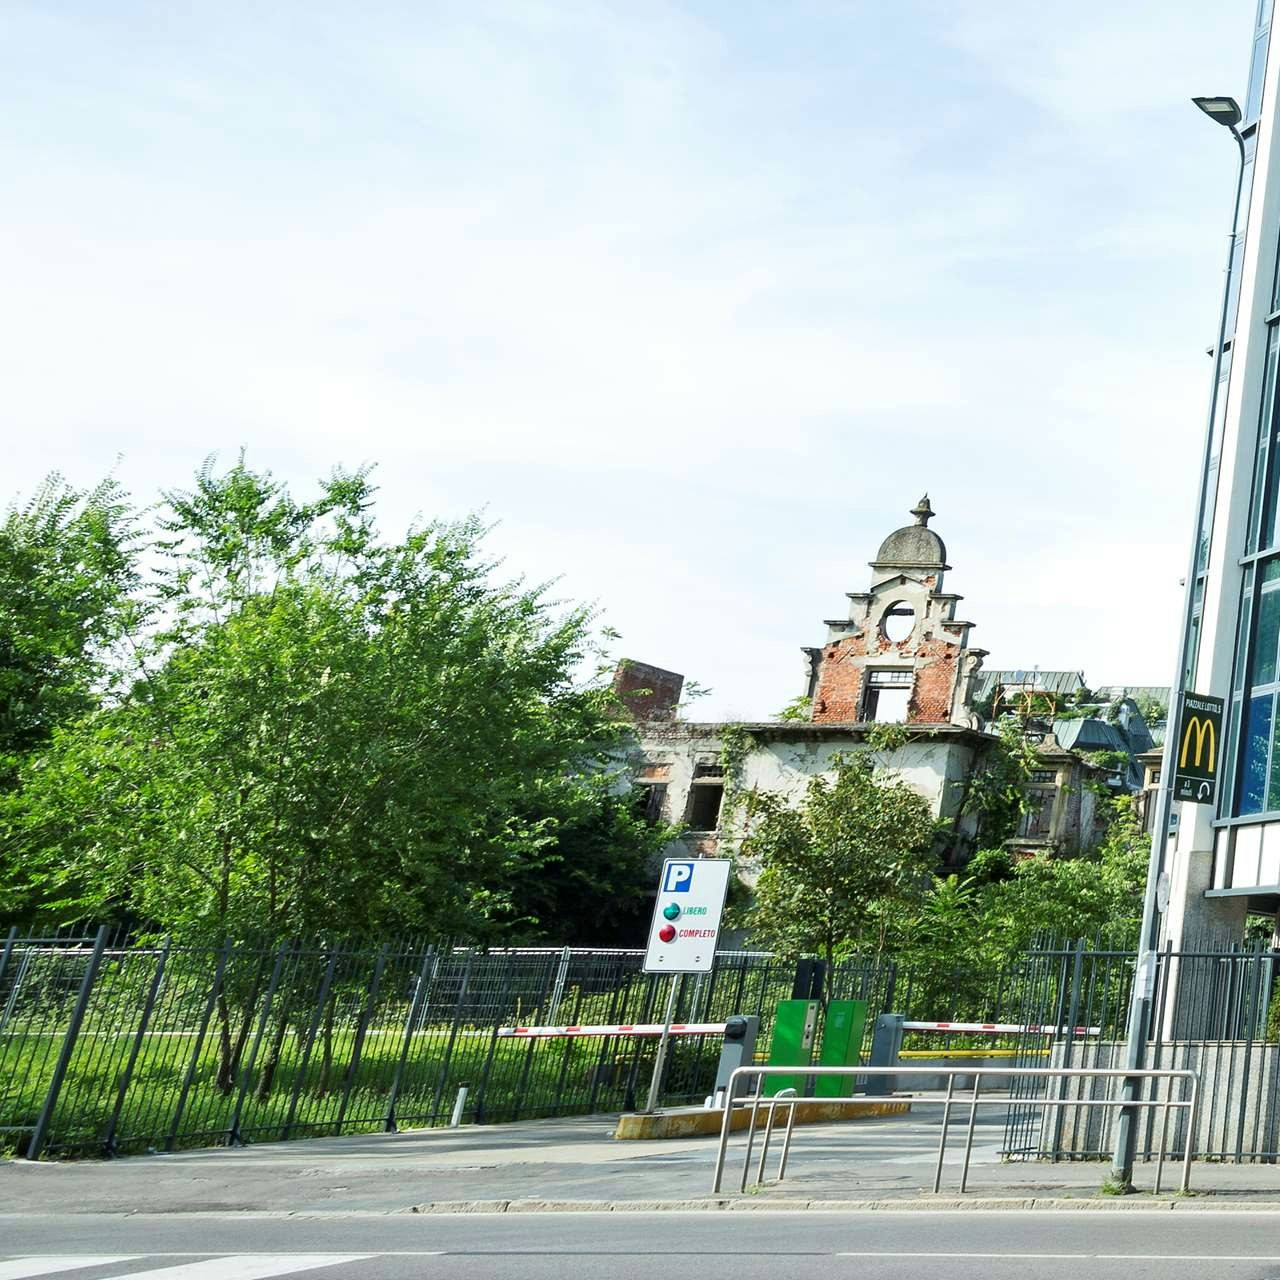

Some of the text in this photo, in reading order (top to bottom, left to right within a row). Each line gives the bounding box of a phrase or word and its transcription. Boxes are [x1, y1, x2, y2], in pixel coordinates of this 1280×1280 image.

[667, 865, 690, 891] P
[682, 907, 707, 915] LIBERO
[678, 929, 716, 938] COMPLETO
